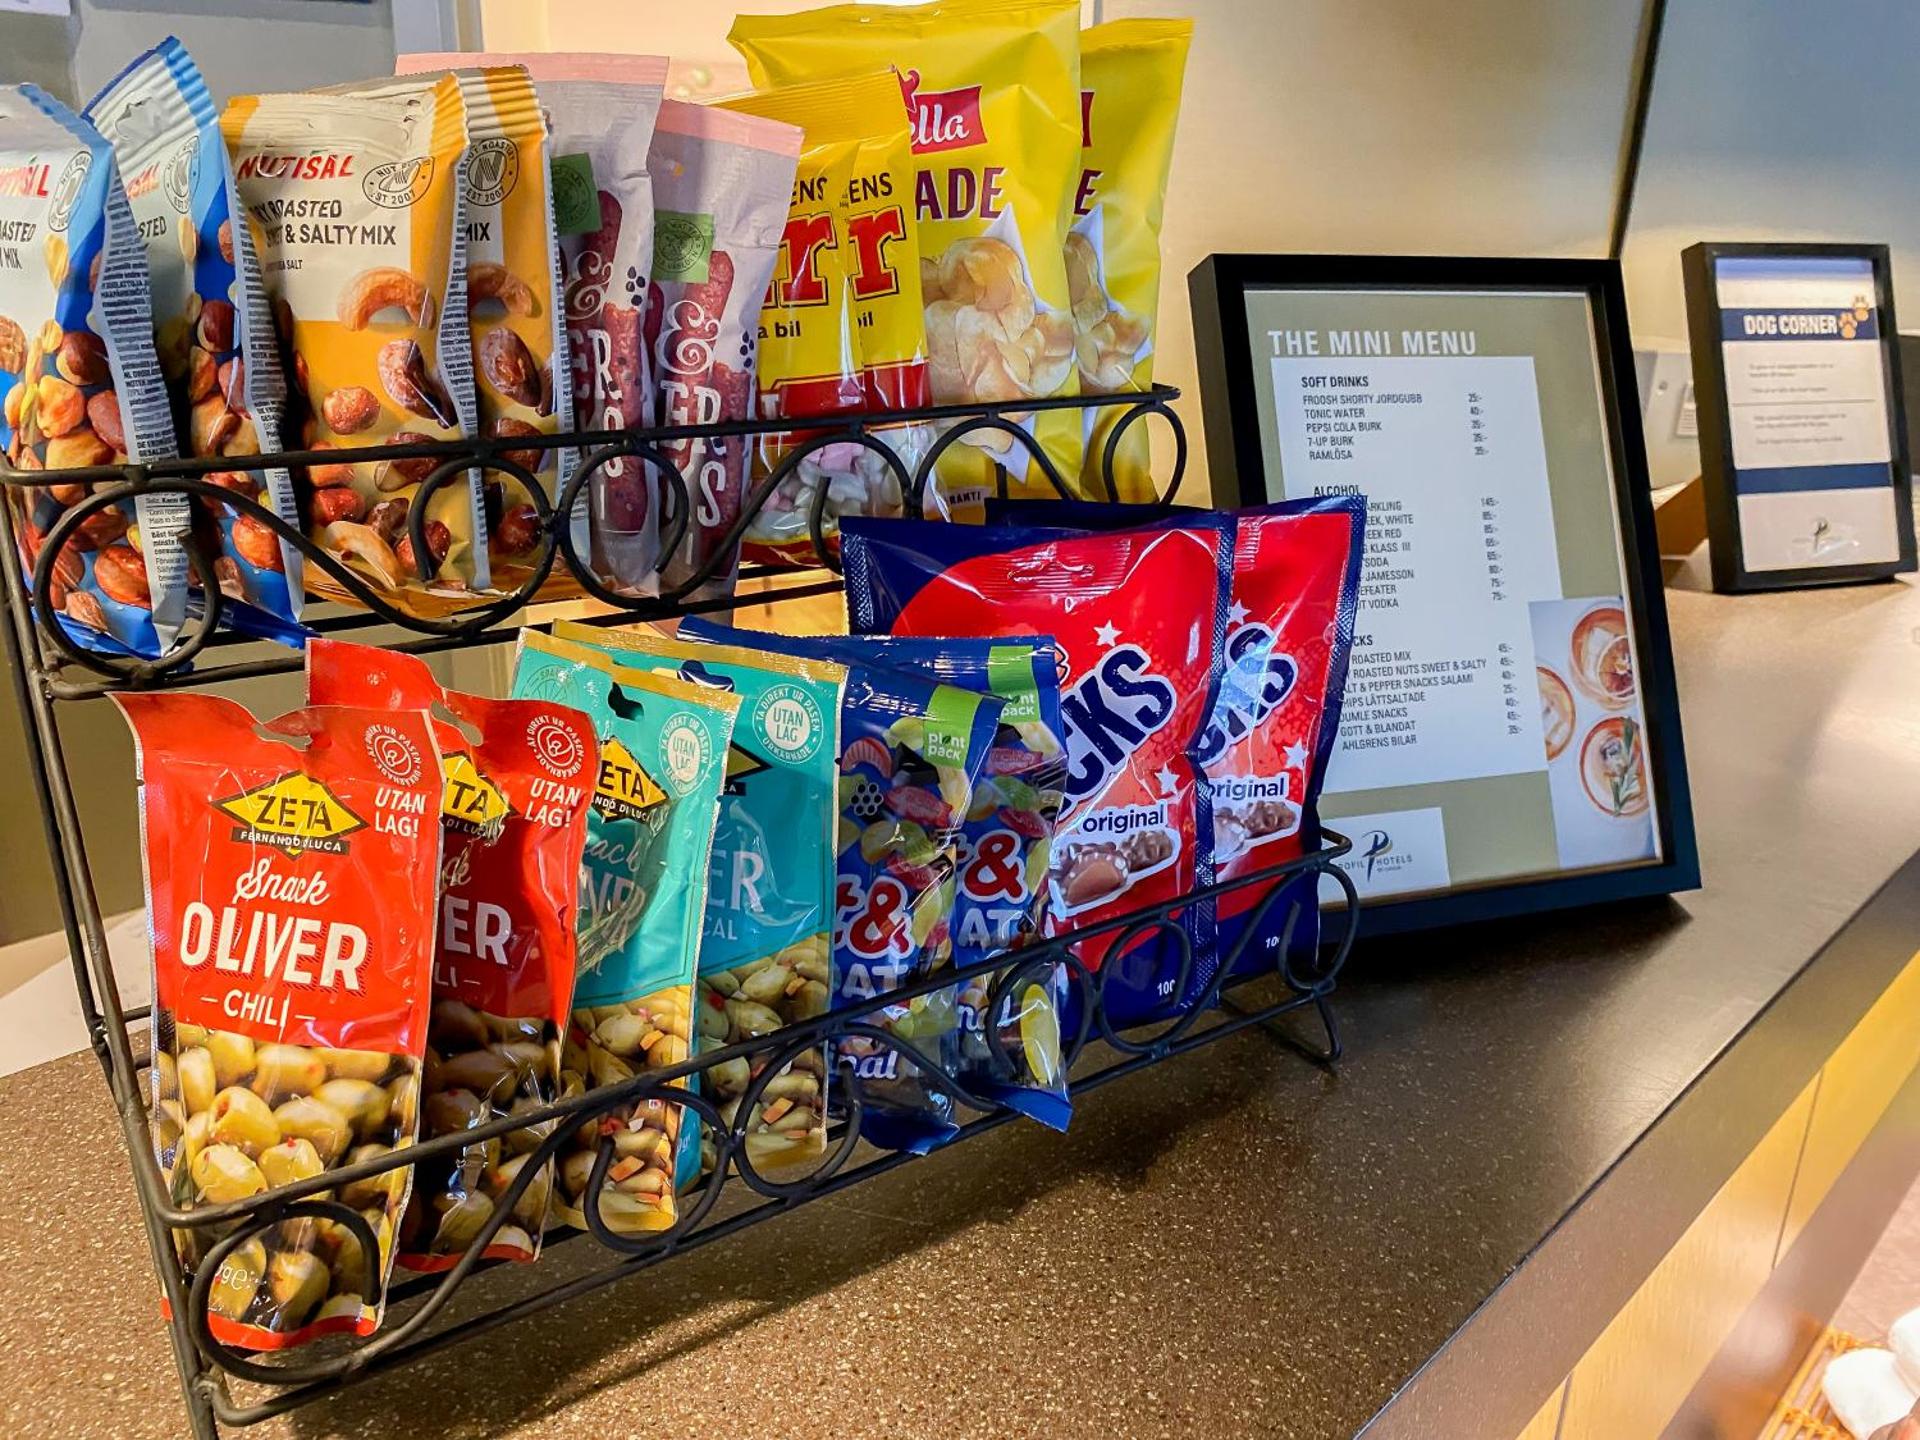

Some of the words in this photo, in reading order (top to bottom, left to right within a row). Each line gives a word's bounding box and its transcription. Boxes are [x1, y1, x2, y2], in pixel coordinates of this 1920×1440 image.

[300, 224, 358, 245] SALTY
[361, 225, 396, 246] MIX
[774, 321, 801, 338] bil
[1743, 314, 1777, 335] DOG
[1778, 314, 1838, 335] CORNER
[1267, 331, 1317, 356] THE
[1328, 331, 1391, 355] MINI
[1402, 330, 1476, 355] MENU
[1301, 376, 1327, 388] SOFT
[1330, 375, 1369, 388] DRINKS
[1303, 394, 1338, 405] FROOSH
[1340, 394, 1373, 405] SHORTY
[1304, 409, 1332, 419] TONIC
[1334, 408, 1365, 419] WATER
[1306, 423, 1332, 433] PEPSI
[1334, 422, 1357, 432] COLA
[1359, 421, 1382, 431] BURK
[1307, 436, 1328, 447] 7-UP
[1330, 436, 1354, 446] BURK
[1309, 448, 1353, 460] RAMLÖSA
[1314, 485, 1361, 497] ALCOHOL
[1385, 514, 1414, 525] WHITE
[1385, 529, 1402, 539] RED
[1371, 543, 1398, 553] KLASS
[1364, 557, 1389, 568] SODA
[1369, 598, 1399, 609] VODKA
[1352, 652, 1392, 665] ROASTED
[1394, 650, 1412, 662] MIX
[1353, 666, 1393, 679] ROASTED
[1396, 664, 1419, 676] NUTS
[1421, 661, 1450, 674] SWEET
[1461, 658, 1487, 670] SALTY
[1369, 679, 1402, 692] PEPPER
[1404, 676, 1440, 689] SNACKS
[1441, 673, 1474, 686] SALAMI
[773, 707, 804, 728] UTAN
[1372, 708, 1408, 720] SNACKS
[776, 725, 798, 742] LAG
[1340, 724, 1363, 737] GOTT
[1374, 720, 1416, 734] BLANDAT
[928, 732, 966, 749] plnt
[1342, 737, 1389, 751] AHLGRENS
[1391, 734, 1417, 747] BILAR
[928, 744, 961, 760] pack
[599, 760, 646, 803] ETA
[375, 786, 426, 815] UTAN
[530, 777, 581, 807] UTAN
[255, 794, 334, 832] ZETA
[524, 801, 572, 828] LAG!
[1083, 809, 1165, 834] original
[375, 811, 419, 839] LAG!
[240, 830, 301, 847] FERNANDO
[1376, 854, 1413, 865] HOTELS
[232, 855, 331, 905] Snack
[444, 893, 512, 966] ER
[179, 900, 369, 992] OLIVER
[223, 989, 290, 1028] CHILI
